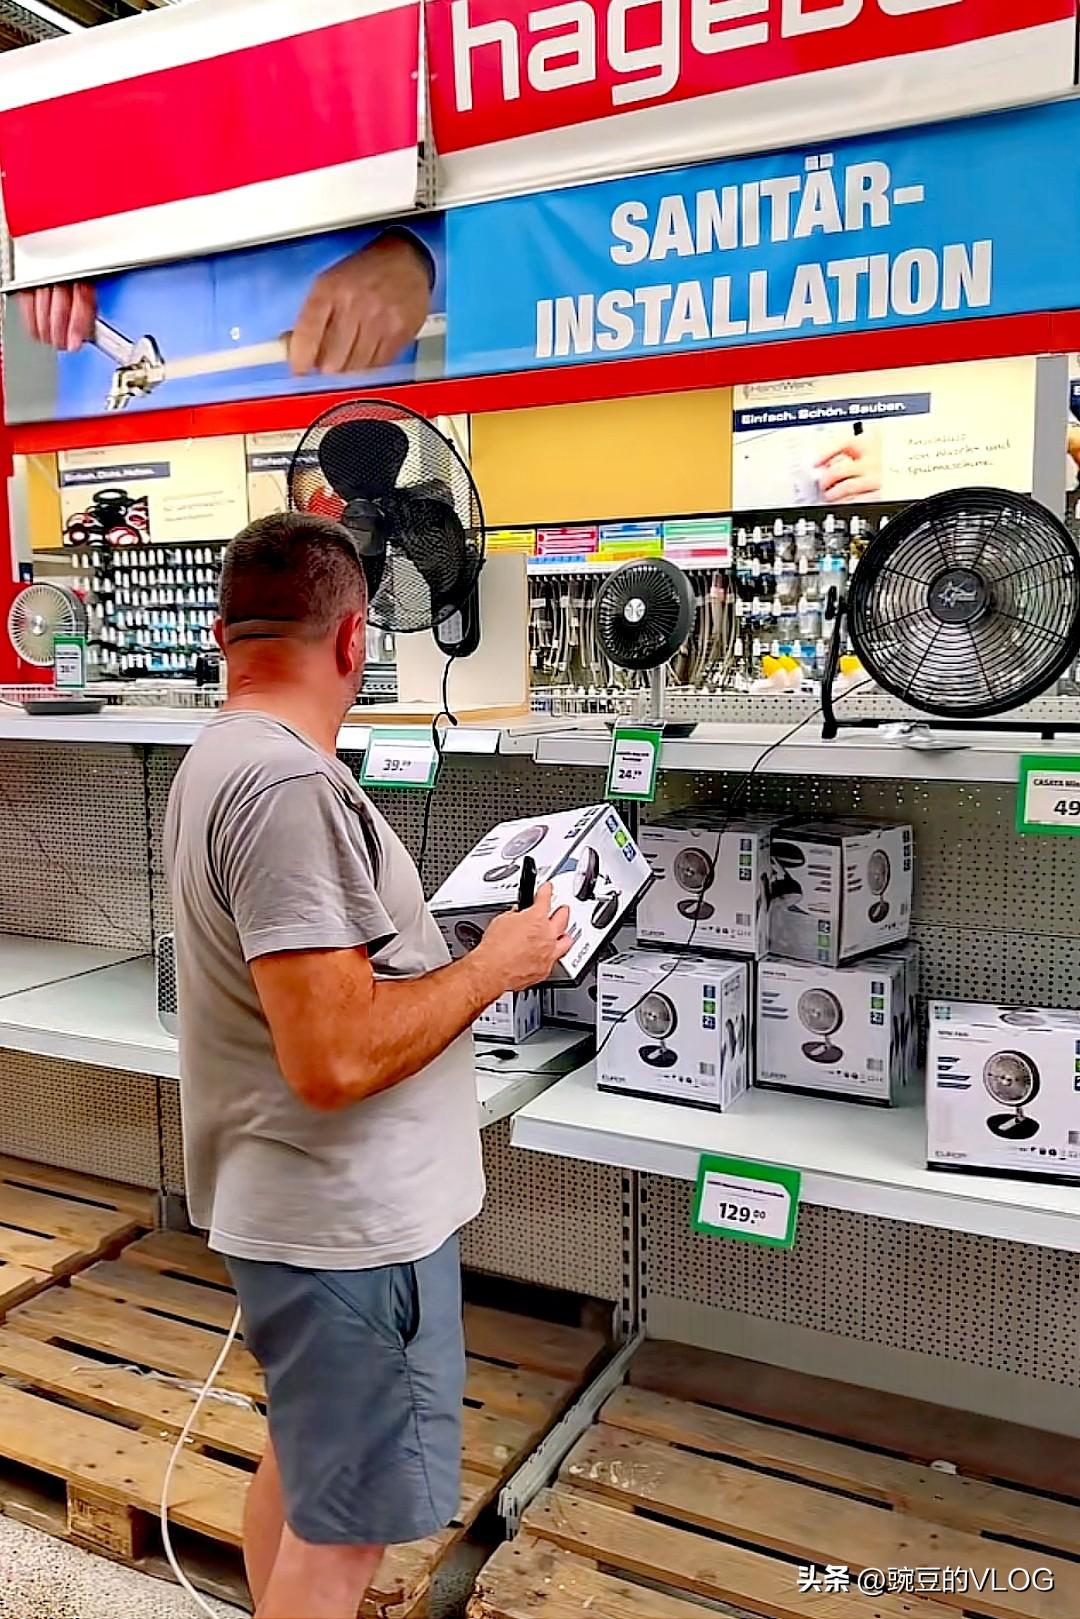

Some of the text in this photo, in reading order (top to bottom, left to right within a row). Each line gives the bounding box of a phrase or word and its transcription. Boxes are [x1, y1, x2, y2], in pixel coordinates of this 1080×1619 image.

[453, 0, 960, 112] hage
[610, 156, 924, 266] SANITÄR-
[534, 240, 992, 359] INSTALLATION
[741, 401, 906, 425] Einfach. Schön. Sauber.
[719, 1202, 766, 1224] 129.00
